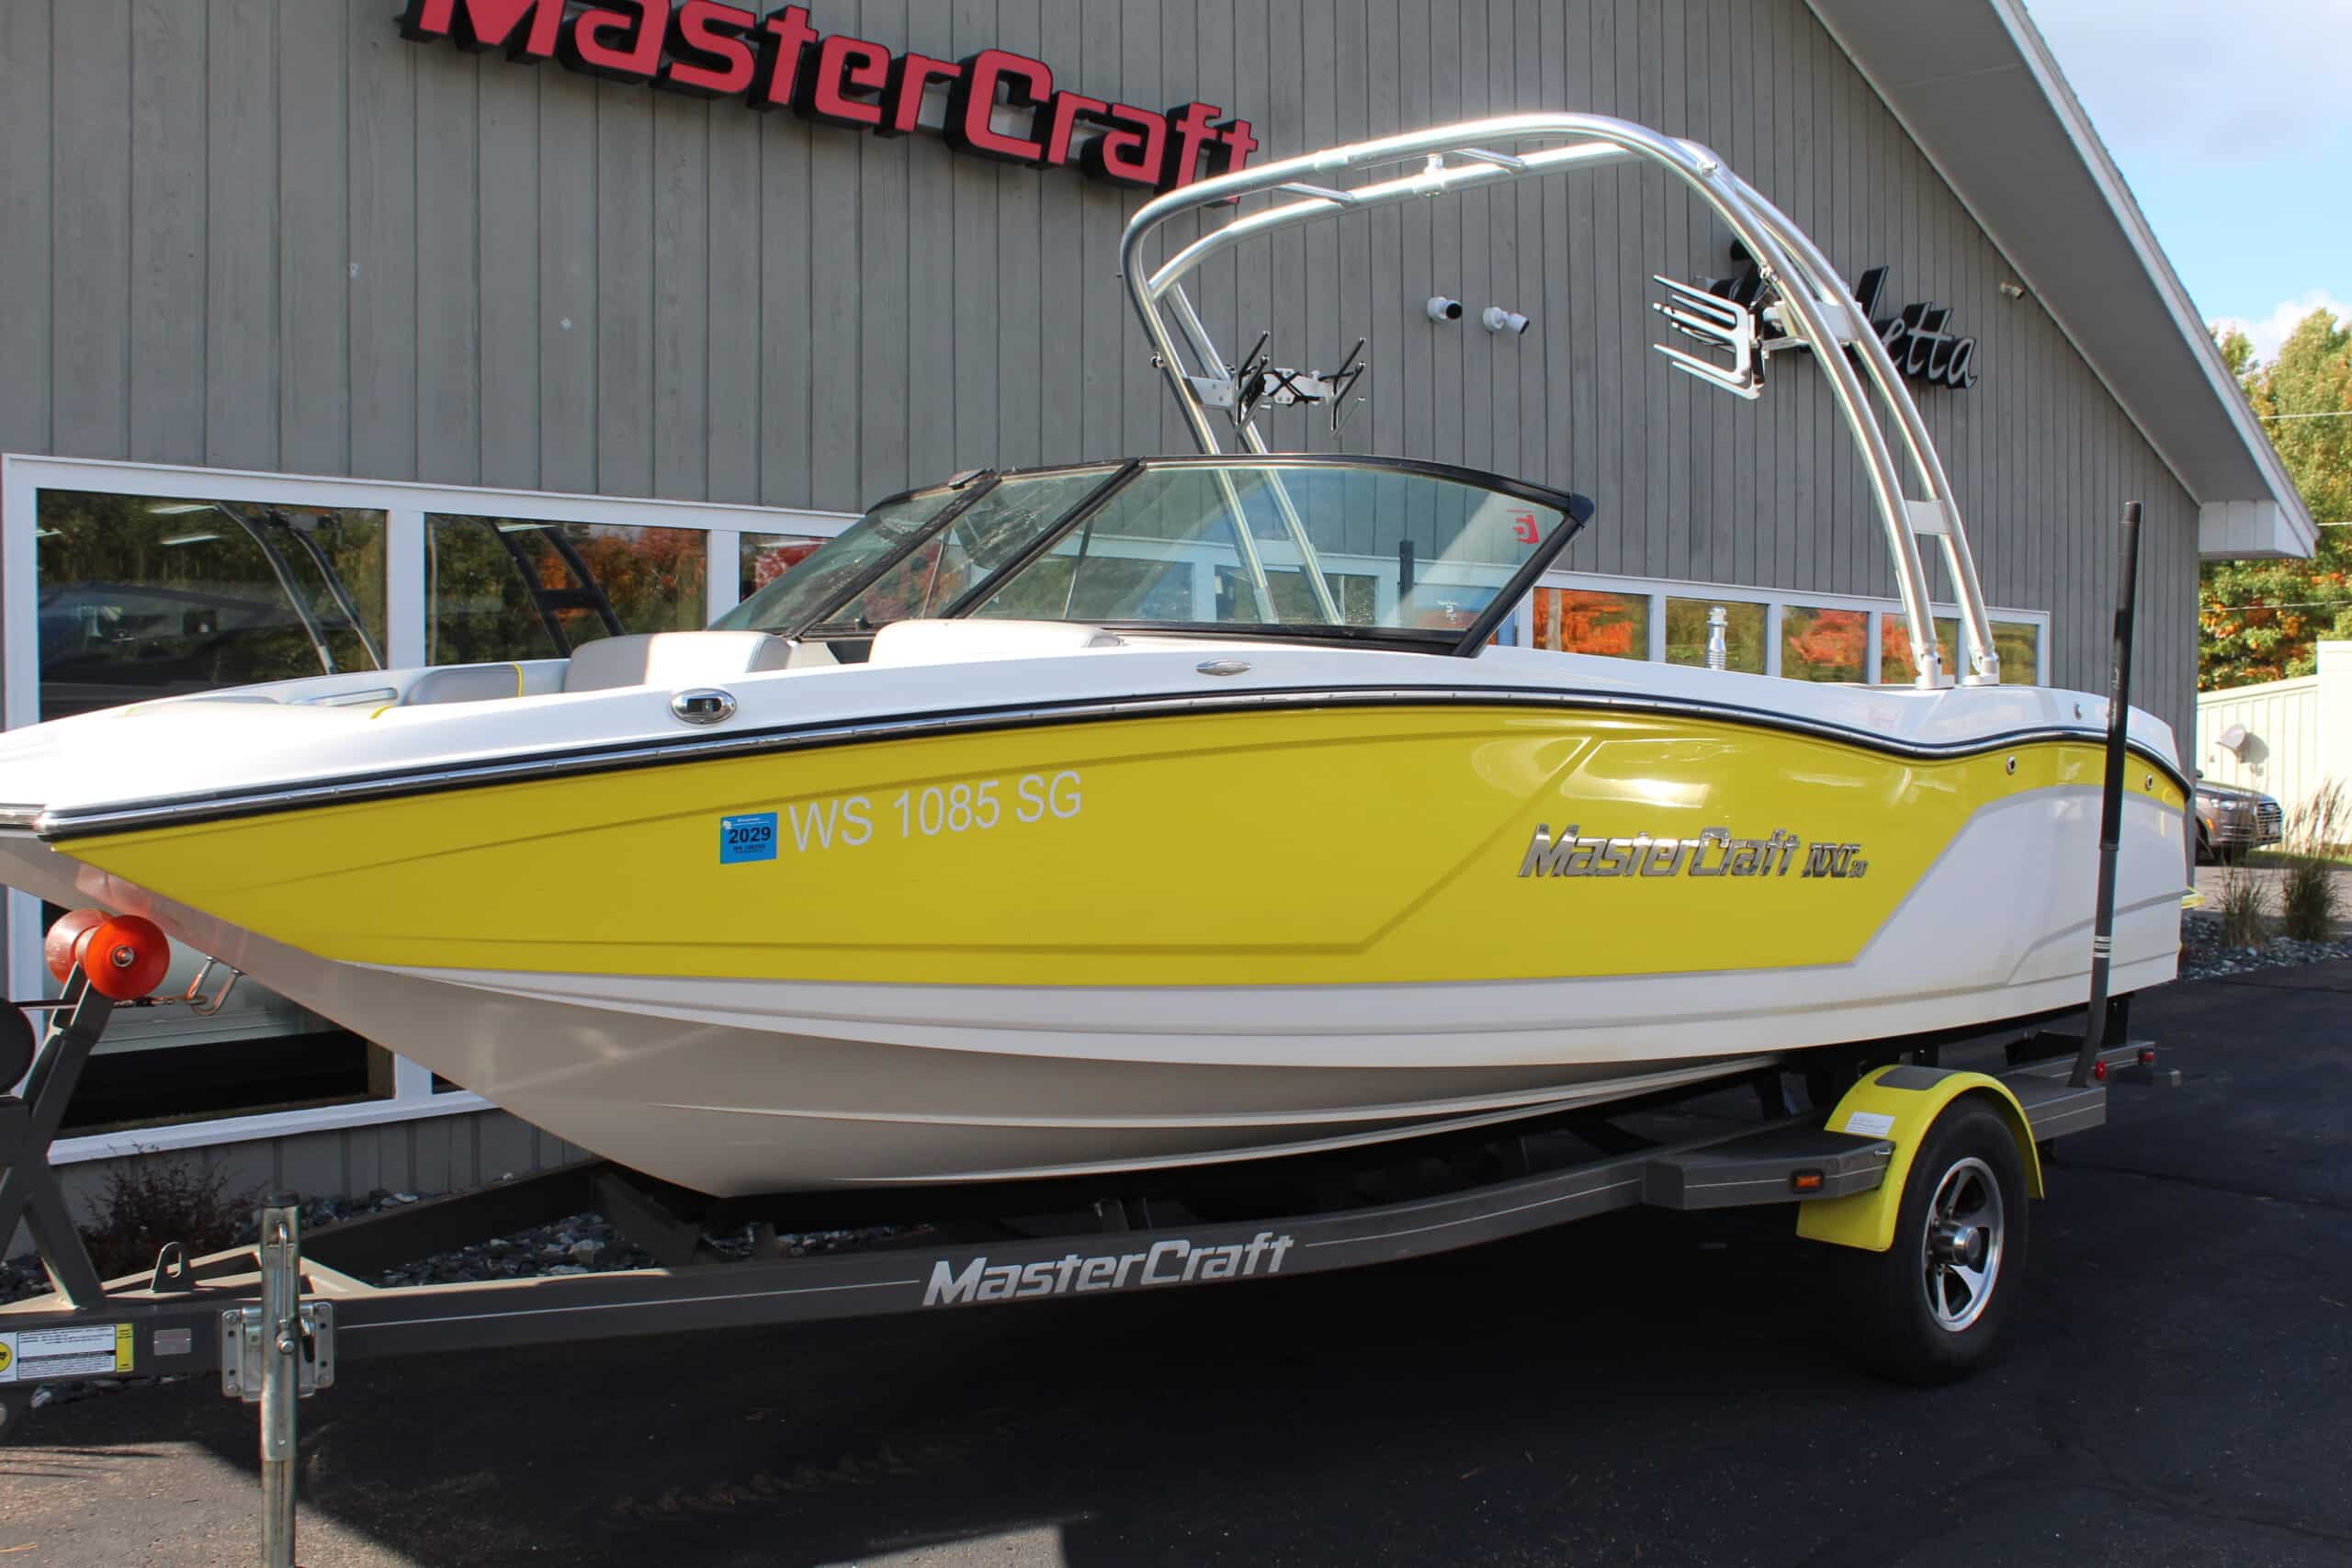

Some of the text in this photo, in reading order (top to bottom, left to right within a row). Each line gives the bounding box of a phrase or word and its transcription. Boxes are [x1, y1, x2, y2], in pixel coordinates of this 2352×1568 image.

[728, 826, 772, 844] 2029
[788, 771, 1082, 852] WS 1085 SG
[1517, 823, 1801, 878] MasterCraft
[922, 1231, 1295, 1307] MasterCraft
